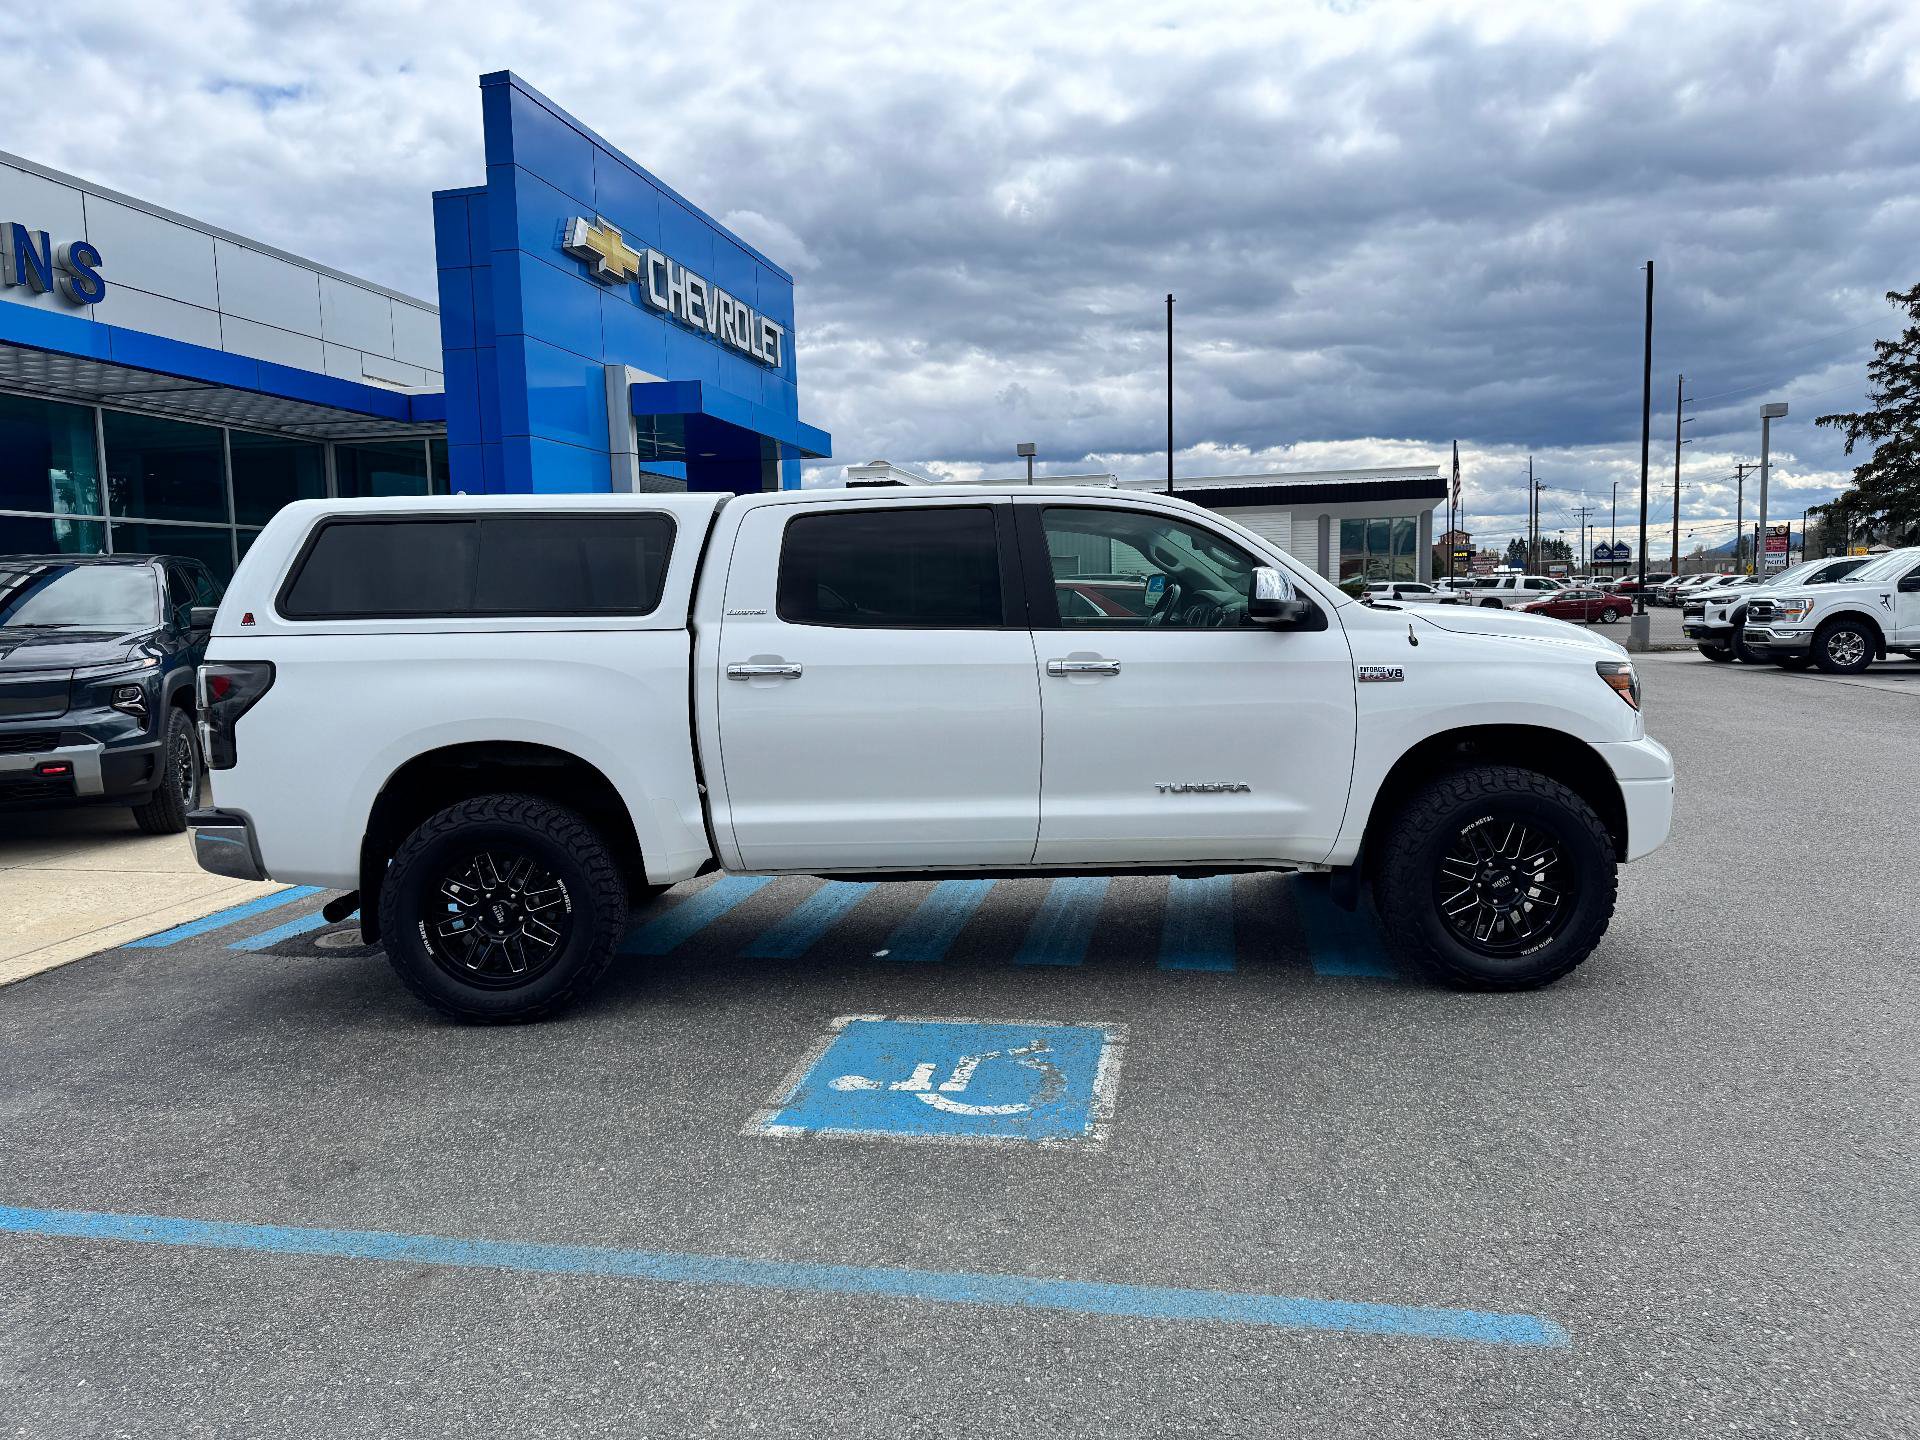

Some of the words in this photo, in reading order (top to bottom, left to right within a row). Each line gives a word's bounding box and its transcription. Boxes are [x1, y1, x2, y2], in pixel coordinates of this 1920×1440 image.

[644, 249, 784, 368] CHEVROLET
[1386, 668, 1403, 678] V8
[1154, 781, 1251, 793] TUNDRA
